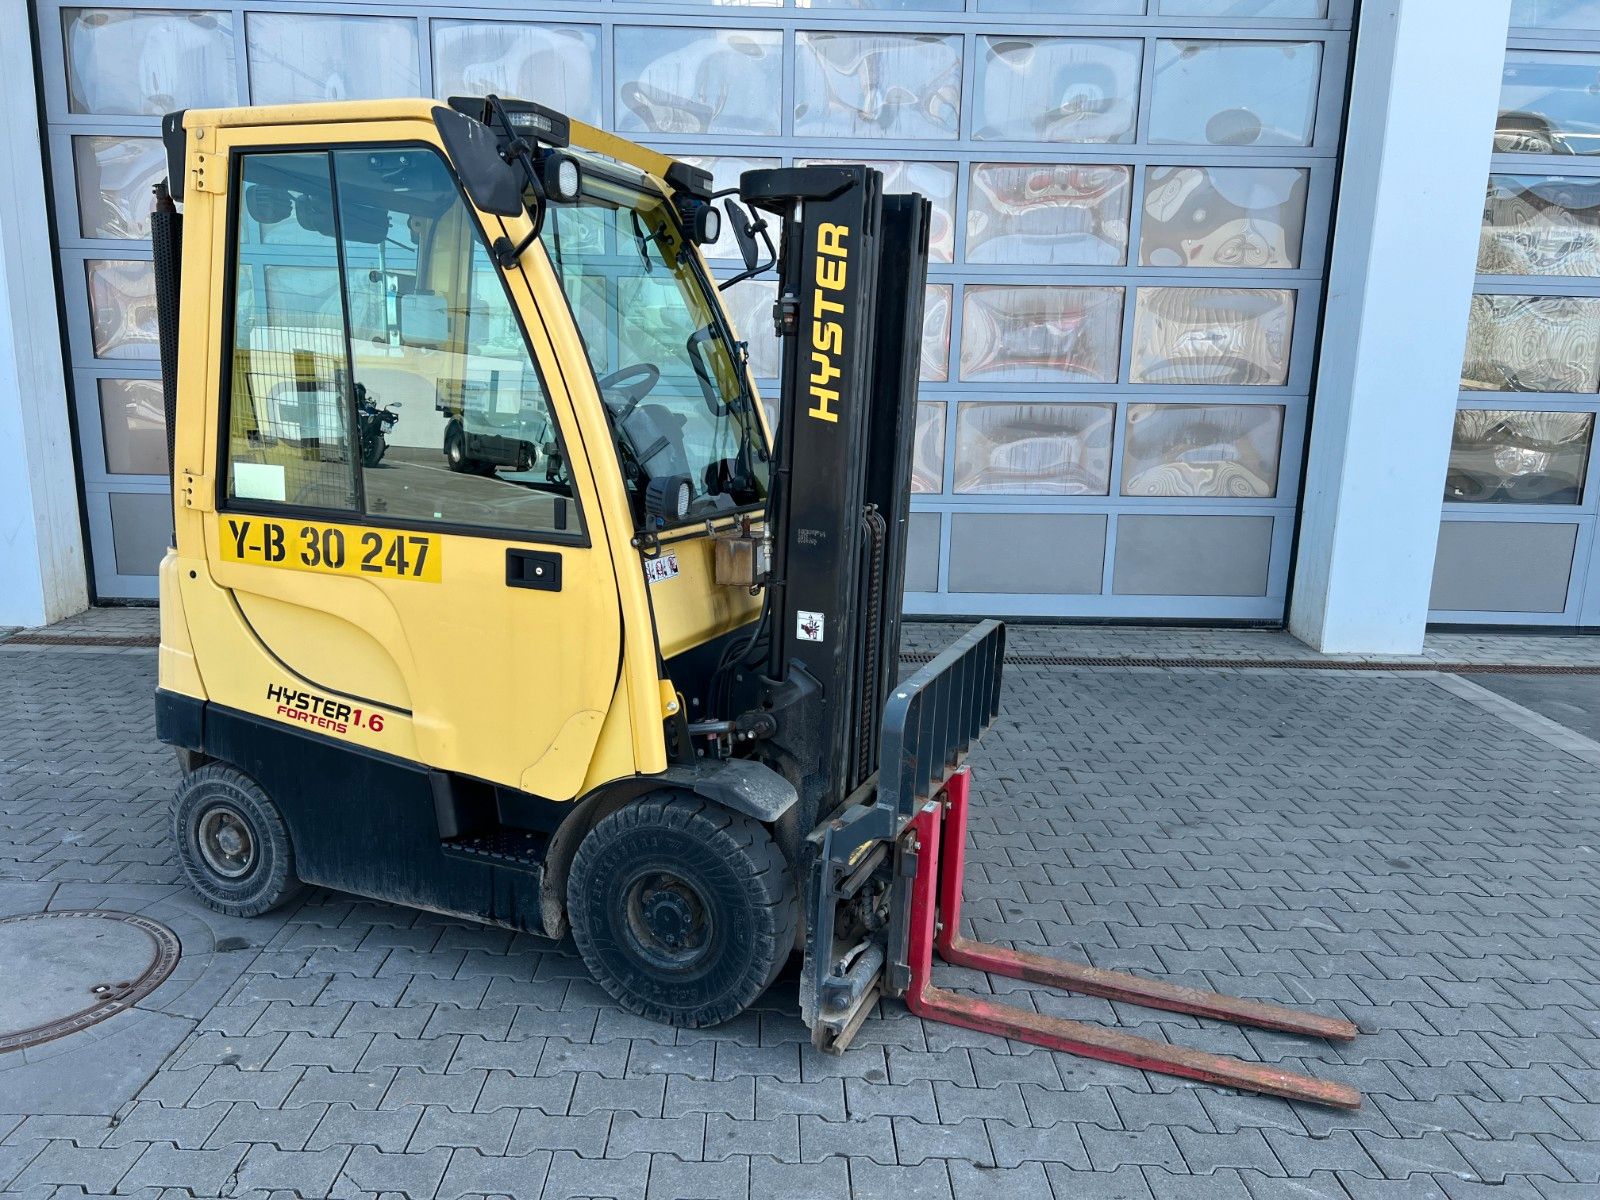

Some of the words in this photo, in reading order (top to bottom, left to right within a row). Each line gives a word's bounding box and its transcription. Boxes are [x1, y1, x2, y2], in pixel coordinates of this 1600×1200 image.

[808, 222, 849, 423] HYSTER
[228, 520, 286, 562] Y-B
[300, 527, 345, 569] 30
[361, 532, 429, 577] 247
[266, 683, 351, 722] HYSTER
[353, 709, 384, 732] 1.6
[277, 705, 347, 734] FORTENS
